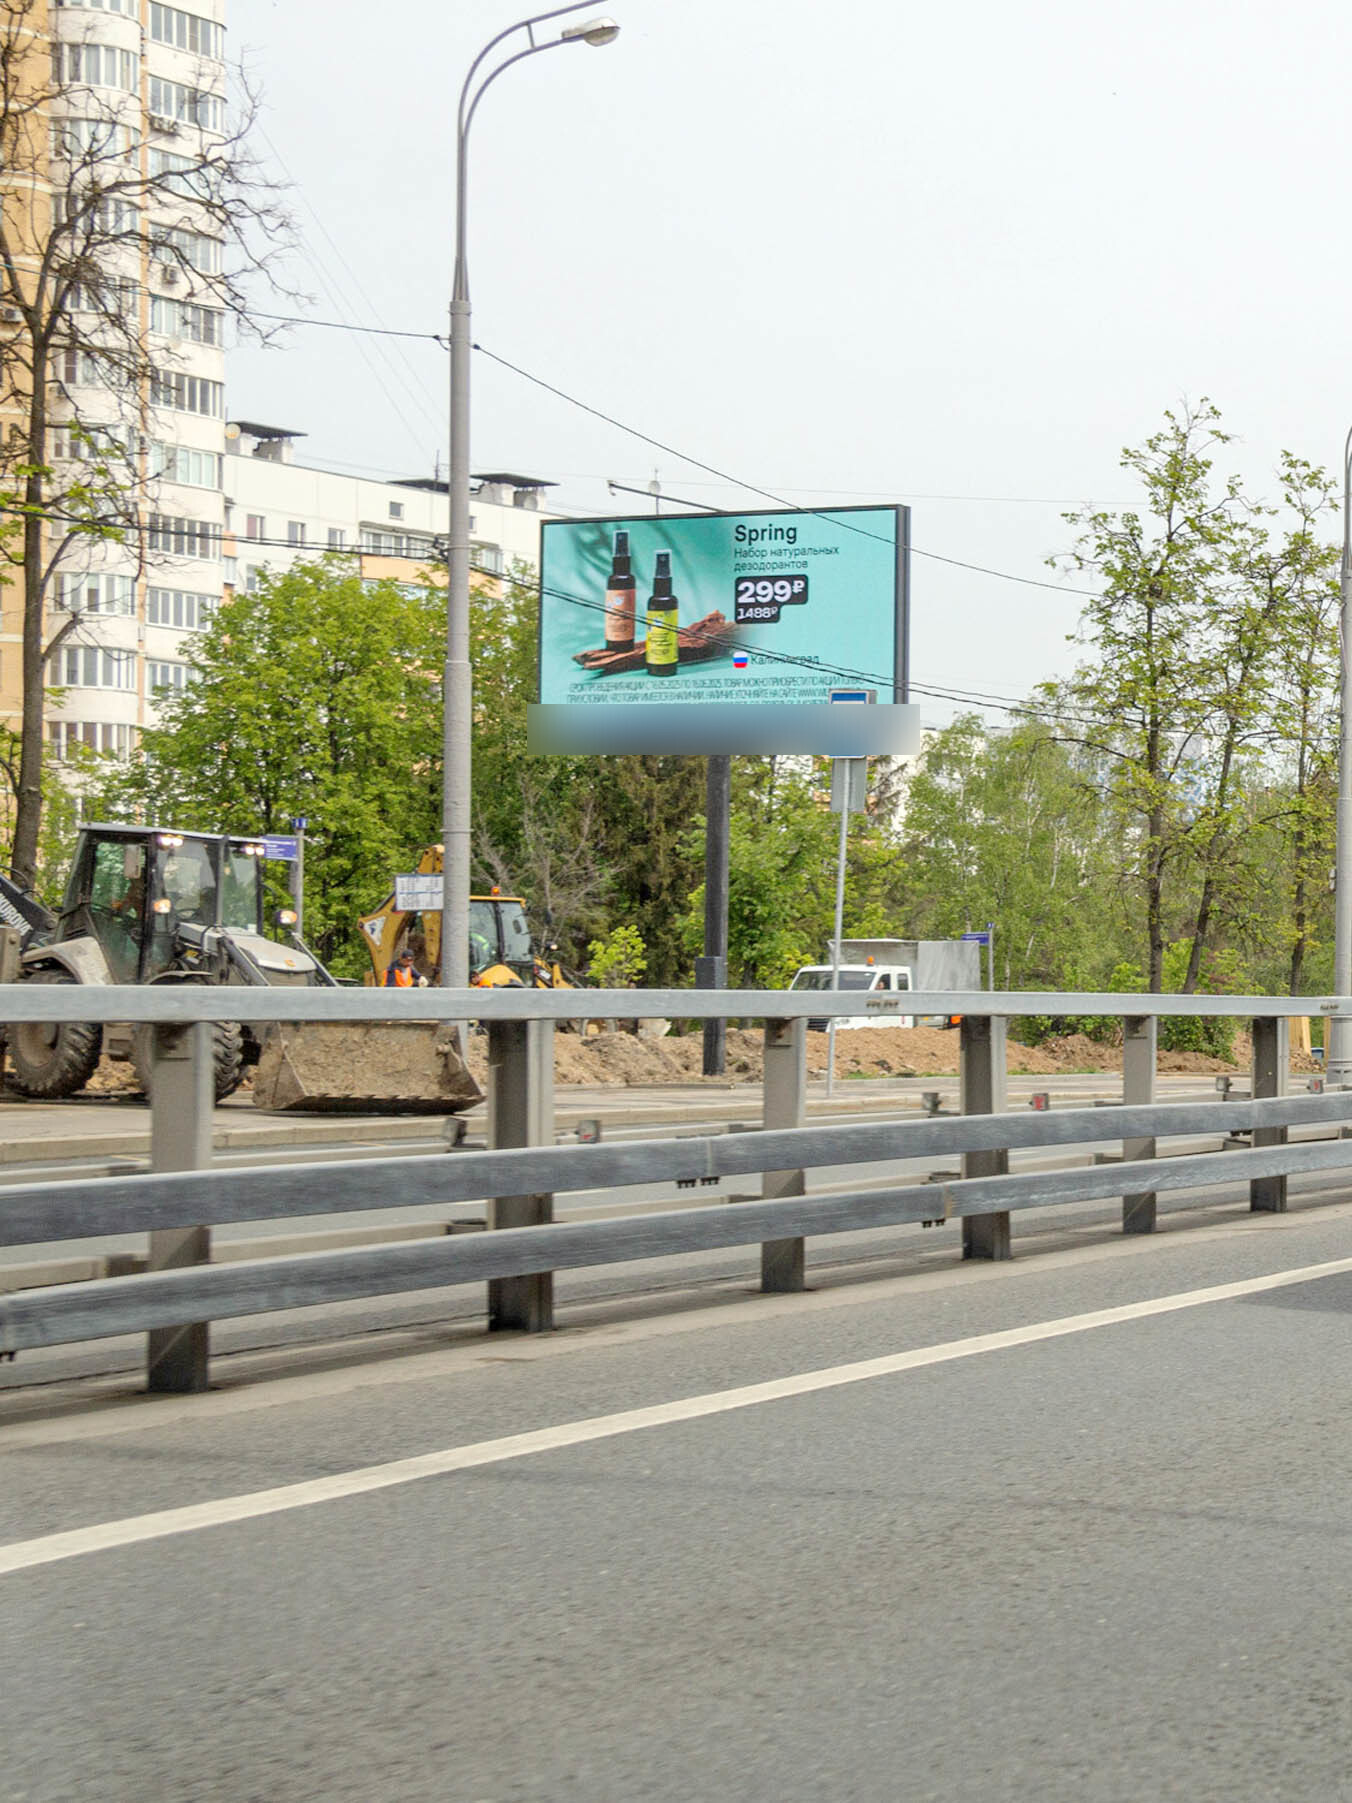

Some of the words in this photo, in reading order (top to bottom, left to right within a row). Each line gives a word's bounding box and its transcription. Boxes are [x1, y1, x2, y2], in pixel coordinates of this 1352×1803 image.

[734, 523, 797, 546] Spring
[734, 547, 768, 560] Набор
[770, 546, 839, 559] натуральных
[734, 560, 808, 572] дезодорантов
